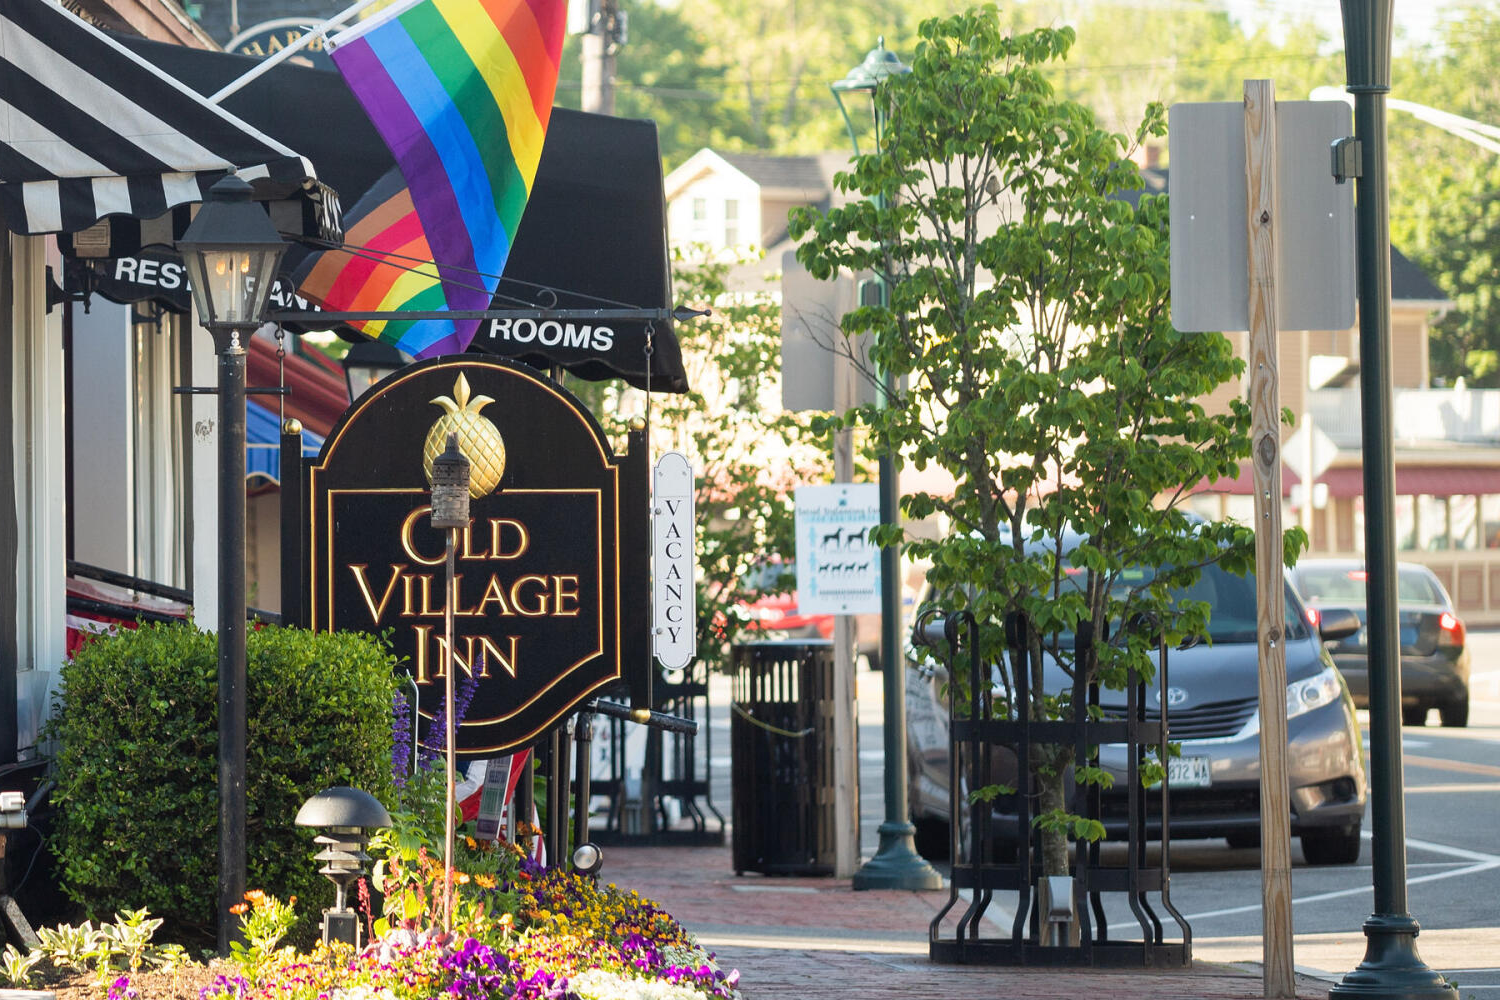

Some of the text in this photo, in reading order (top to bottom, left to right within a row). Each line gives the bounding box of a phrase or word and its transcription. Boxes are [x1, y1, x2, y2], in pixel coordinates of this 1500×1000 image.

[489, 318, 615, 352] ROOMS
[401, 505, 531, 566] OLD
[348, 563, 581, 626] VILLAGE
[665, 499, 683, 644] VACANCY
[412, 624, 521, 685] INN
